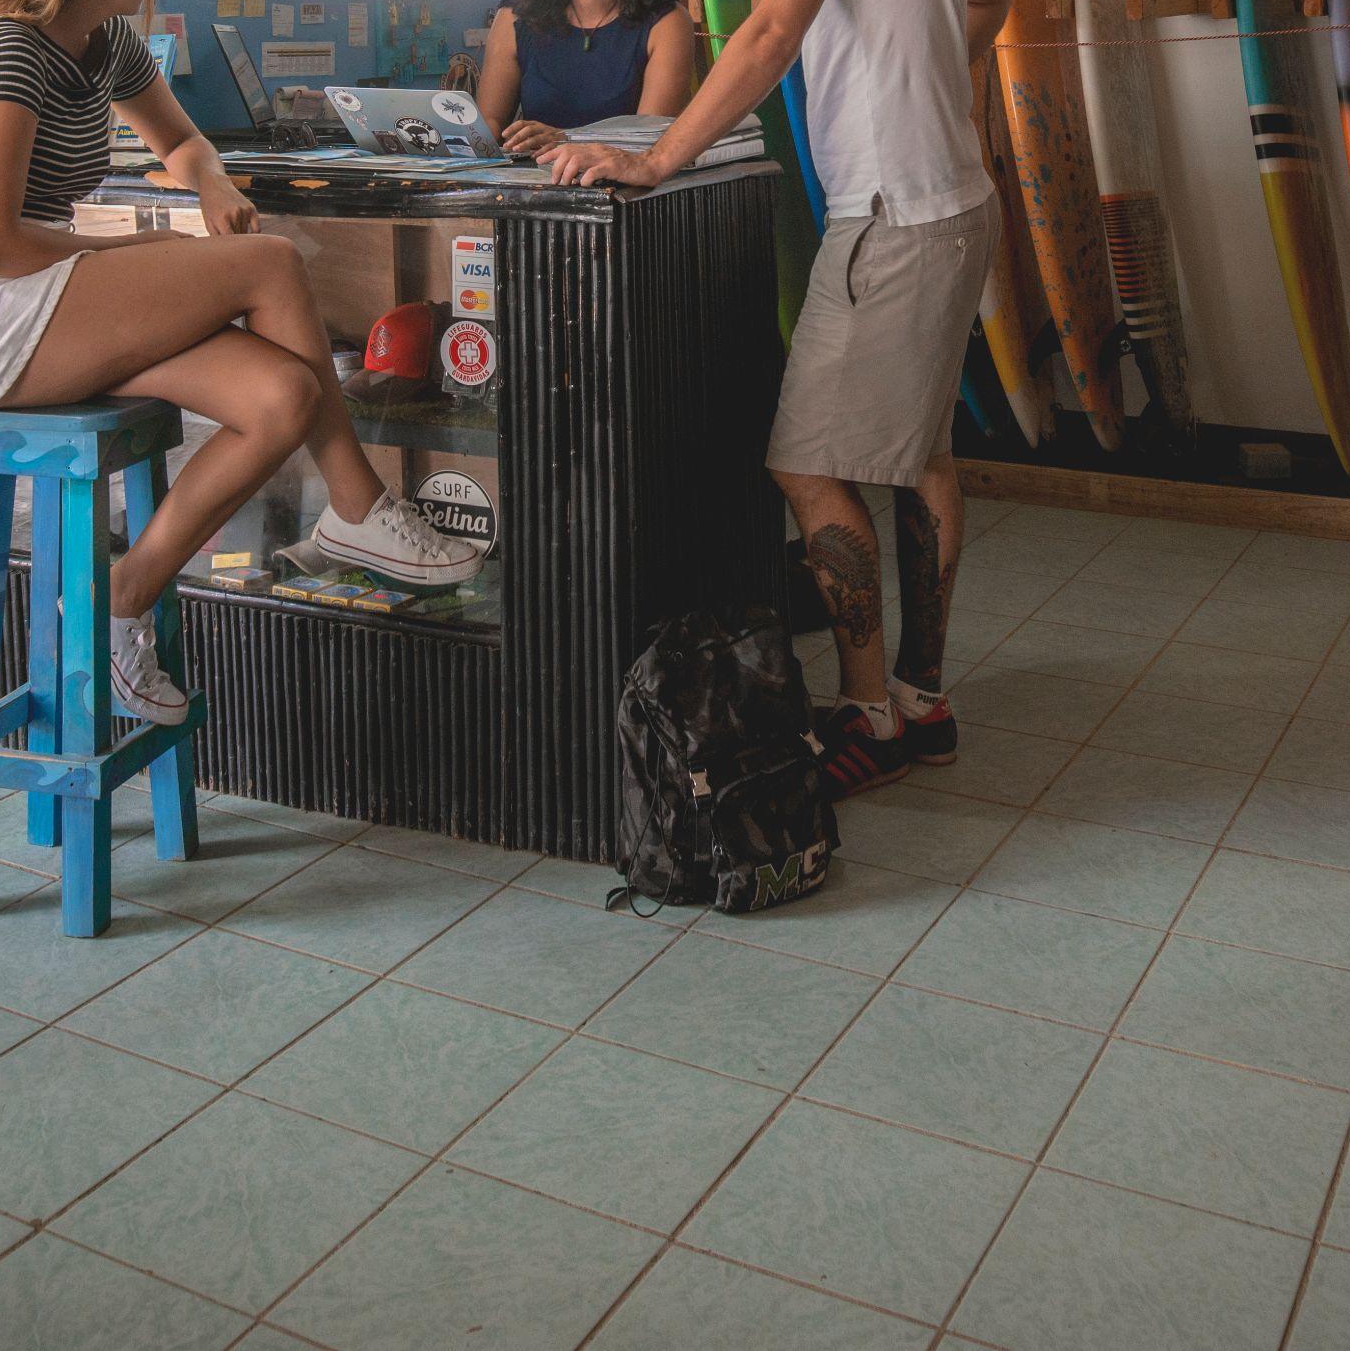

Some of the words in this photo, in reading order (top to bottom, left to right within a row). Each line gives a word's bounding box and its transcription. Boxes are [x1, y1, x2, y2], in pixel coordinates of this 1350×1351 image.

[475, 242, 494, 253] BCR
[461, 263, 491, 277] VISA
[447, 323, 488, 340] LIFEGUARDS
[451, 369, 490, 383] GUARDAVIDAS
[432, 480, 473, 499] SURF
[421, 501, 489, 534] Selina
